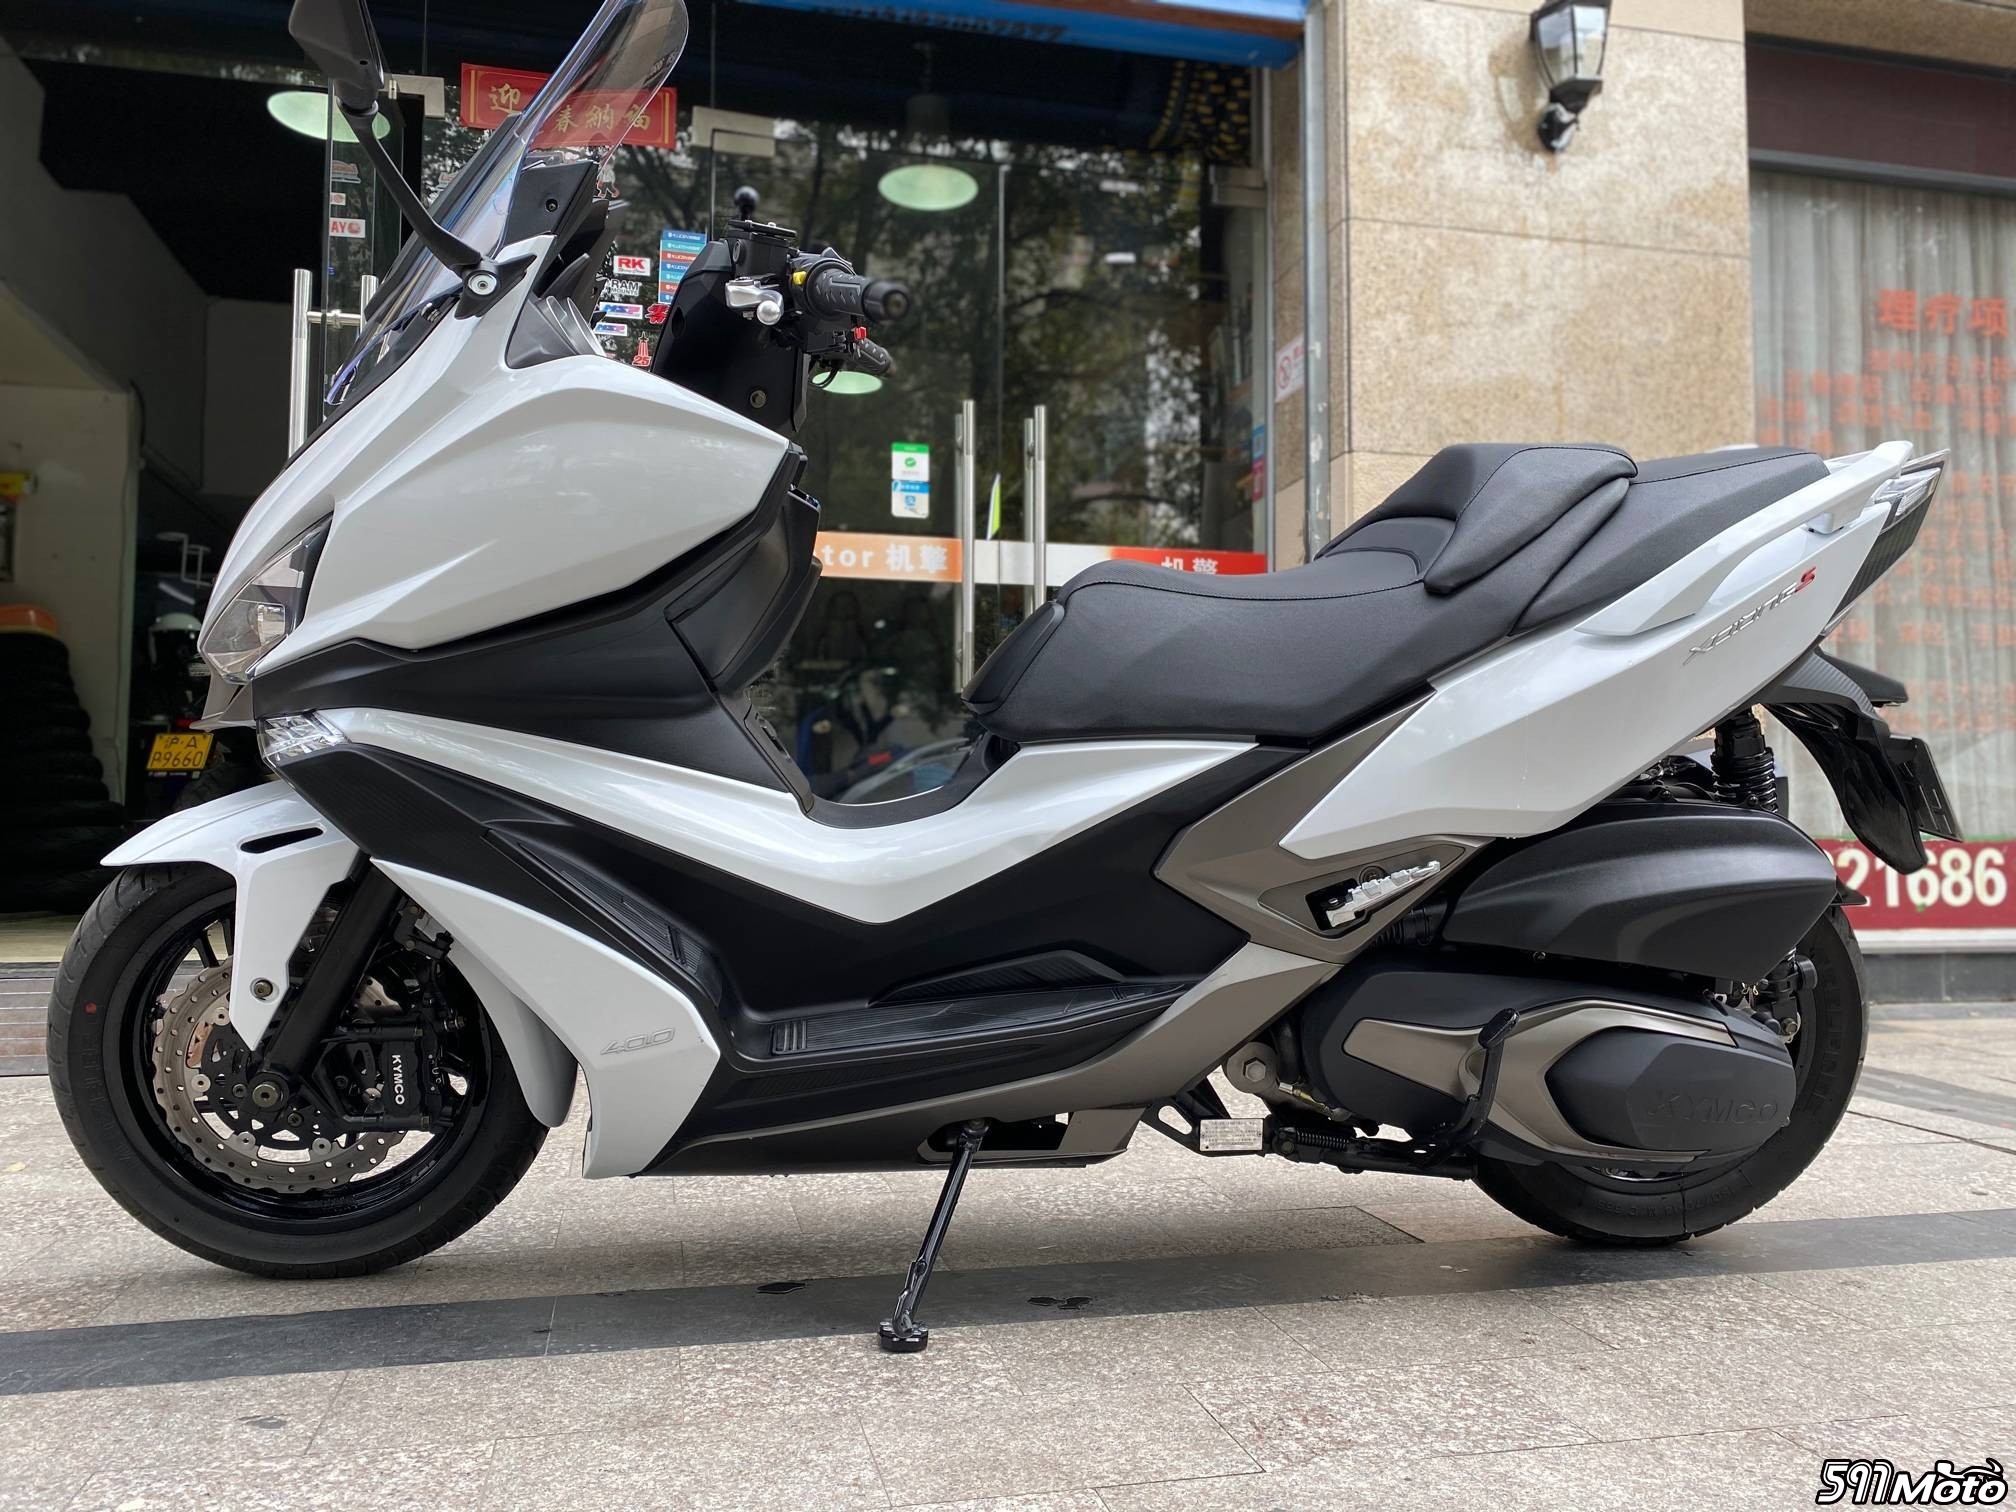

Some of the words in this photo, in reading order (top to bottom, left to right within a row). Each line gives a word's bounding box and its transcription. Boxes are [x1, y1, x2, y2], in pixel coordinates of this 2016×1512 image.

[618, 257, 645, 270] RK
[611, 280, 639, 291] RAM
[150, 751, 204, 768] P9660
[1824, 847, 2007, 908] 21686
[600, 1027, 675, 1055] 400
[392, 1054, 405, 1105] KYMCO
